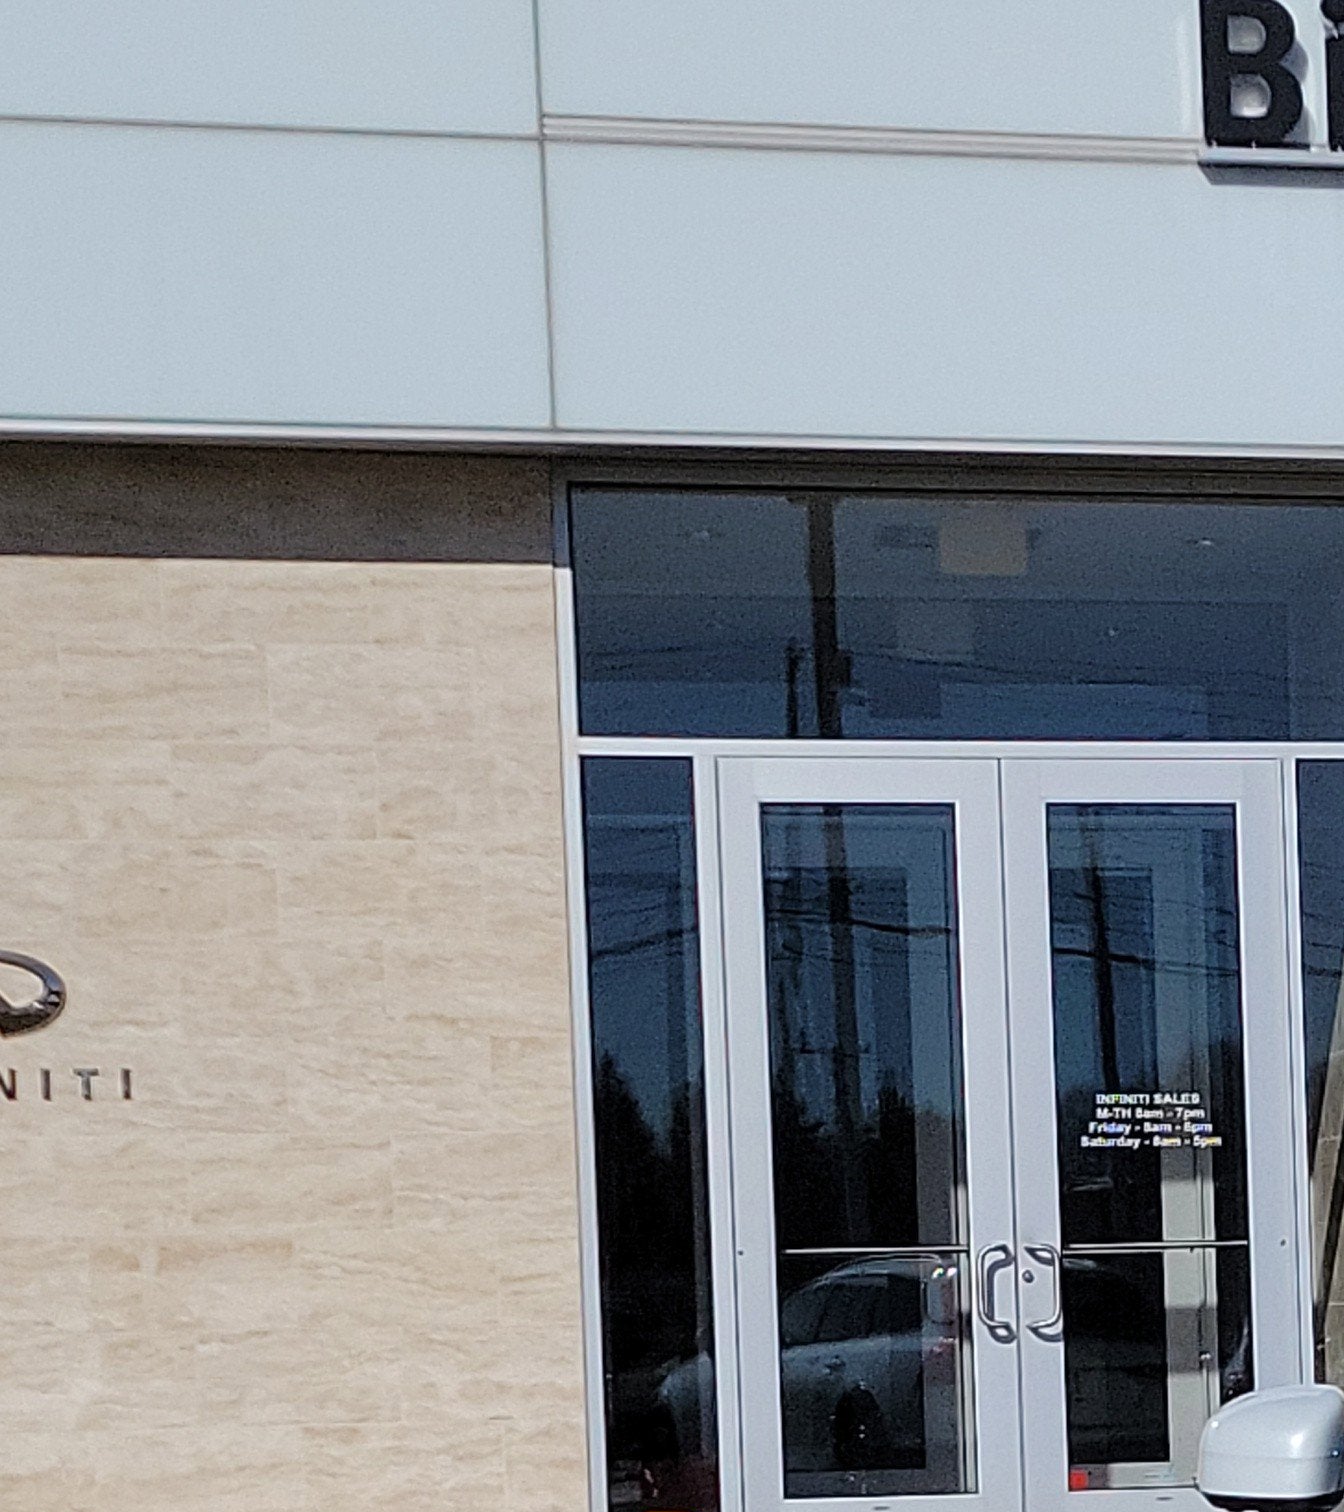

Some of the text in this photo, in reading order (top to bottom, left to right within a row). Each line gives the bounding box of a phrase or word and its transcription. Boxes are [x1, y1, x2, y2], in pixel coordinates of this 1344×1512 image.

[1095, 1092, 1200, 1104] INFINITI SALES
[1096, 1107, 1132, 1119] M-TH
[1175, 1107, 1205, 1120] 7pm
[1088, 1121, 1131, 1135] Friday
[1080, 1135, 1141, 1150] Saturday
